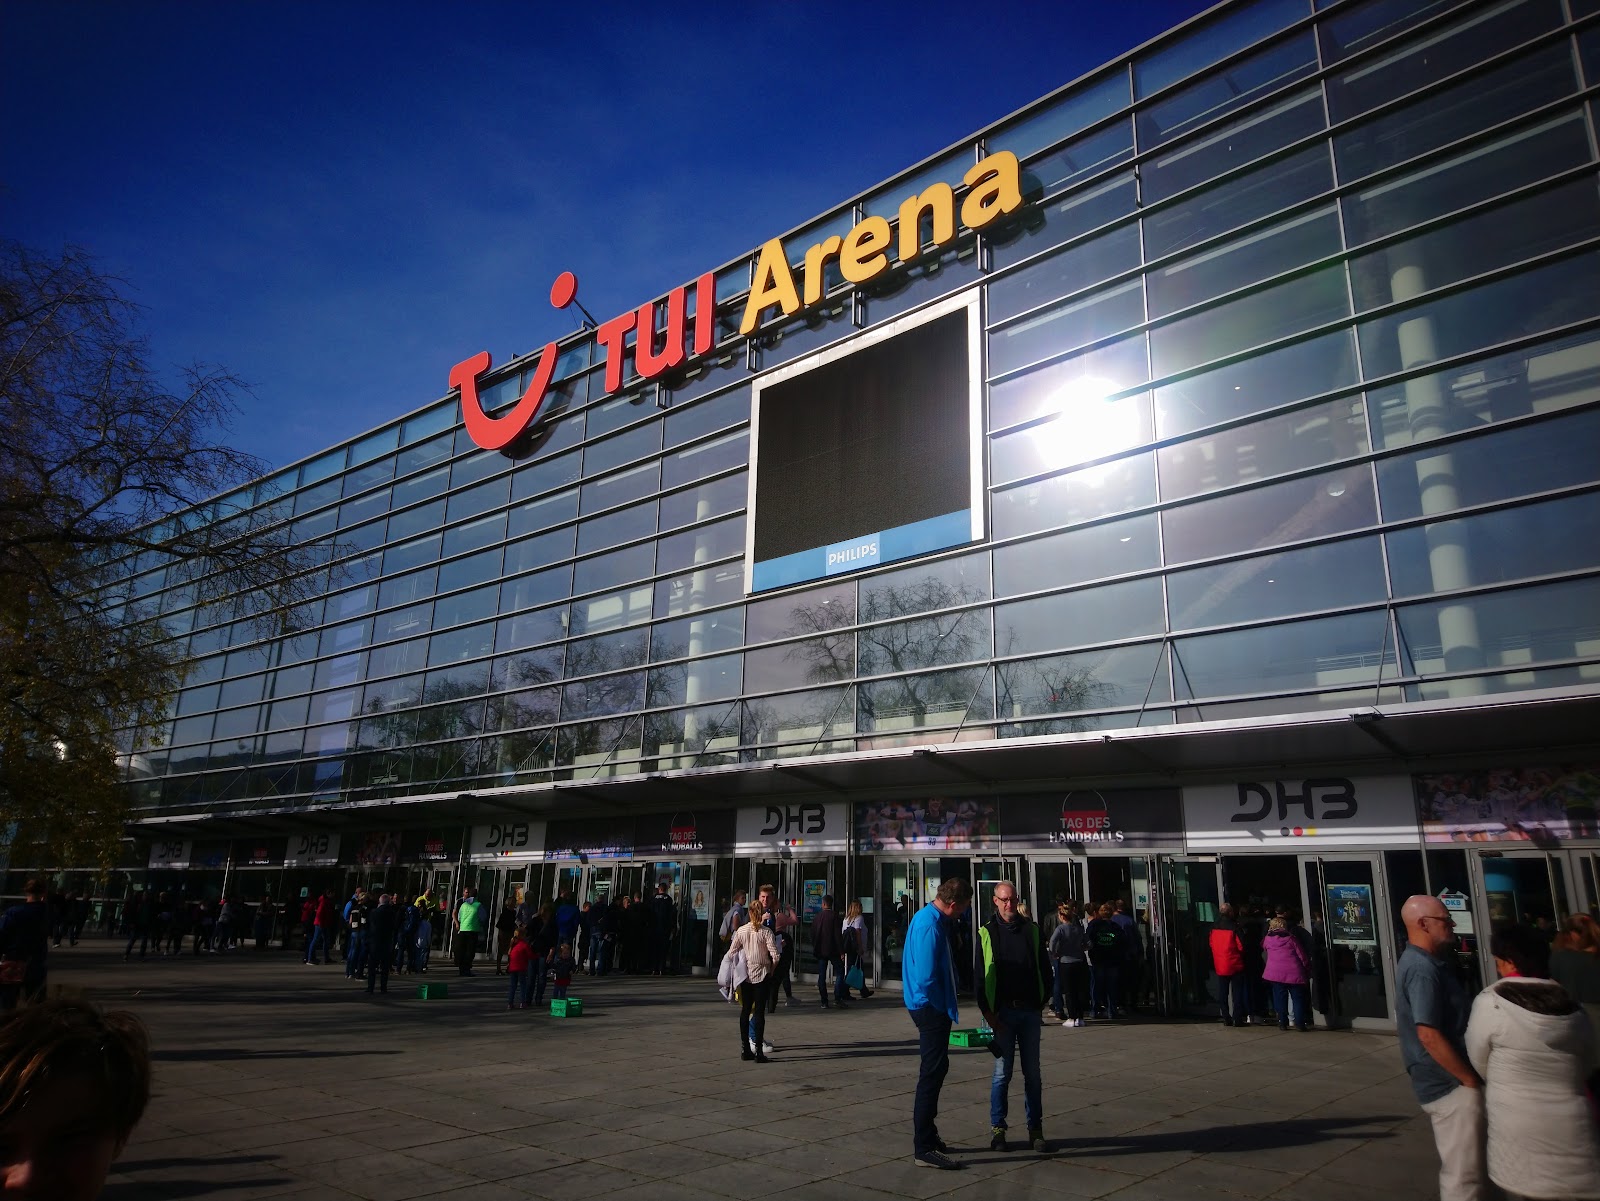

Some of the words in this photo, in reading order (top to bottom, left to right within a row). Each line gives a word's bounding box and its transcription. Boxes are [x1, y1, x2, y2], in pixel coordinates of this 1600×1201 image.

[597, 272, 717, 394] TUI
[739, 150, 1023, 335] Arena
[828, 542, 878, 566] PHILIPS
[1230, 777, 1358, 823] DHB
[760, 803, 826, 836] DHB
[1060, 817, 1085, 829] TAG
[1086, 816, 1110, 828] DES
[297, 833, 329, 854] DHB
[485, 823, 529, 848] DHB
[668, 831, 683, 841] TAG
[684, 830, 697, 840] DES
[1049, 830, 1124, 843] HANDBALLS
[159, 841, 183, 858] DHB
[418, 852, 448, 860] HANDBALLS
[661, 841, 704, 852] HANDBALLS
